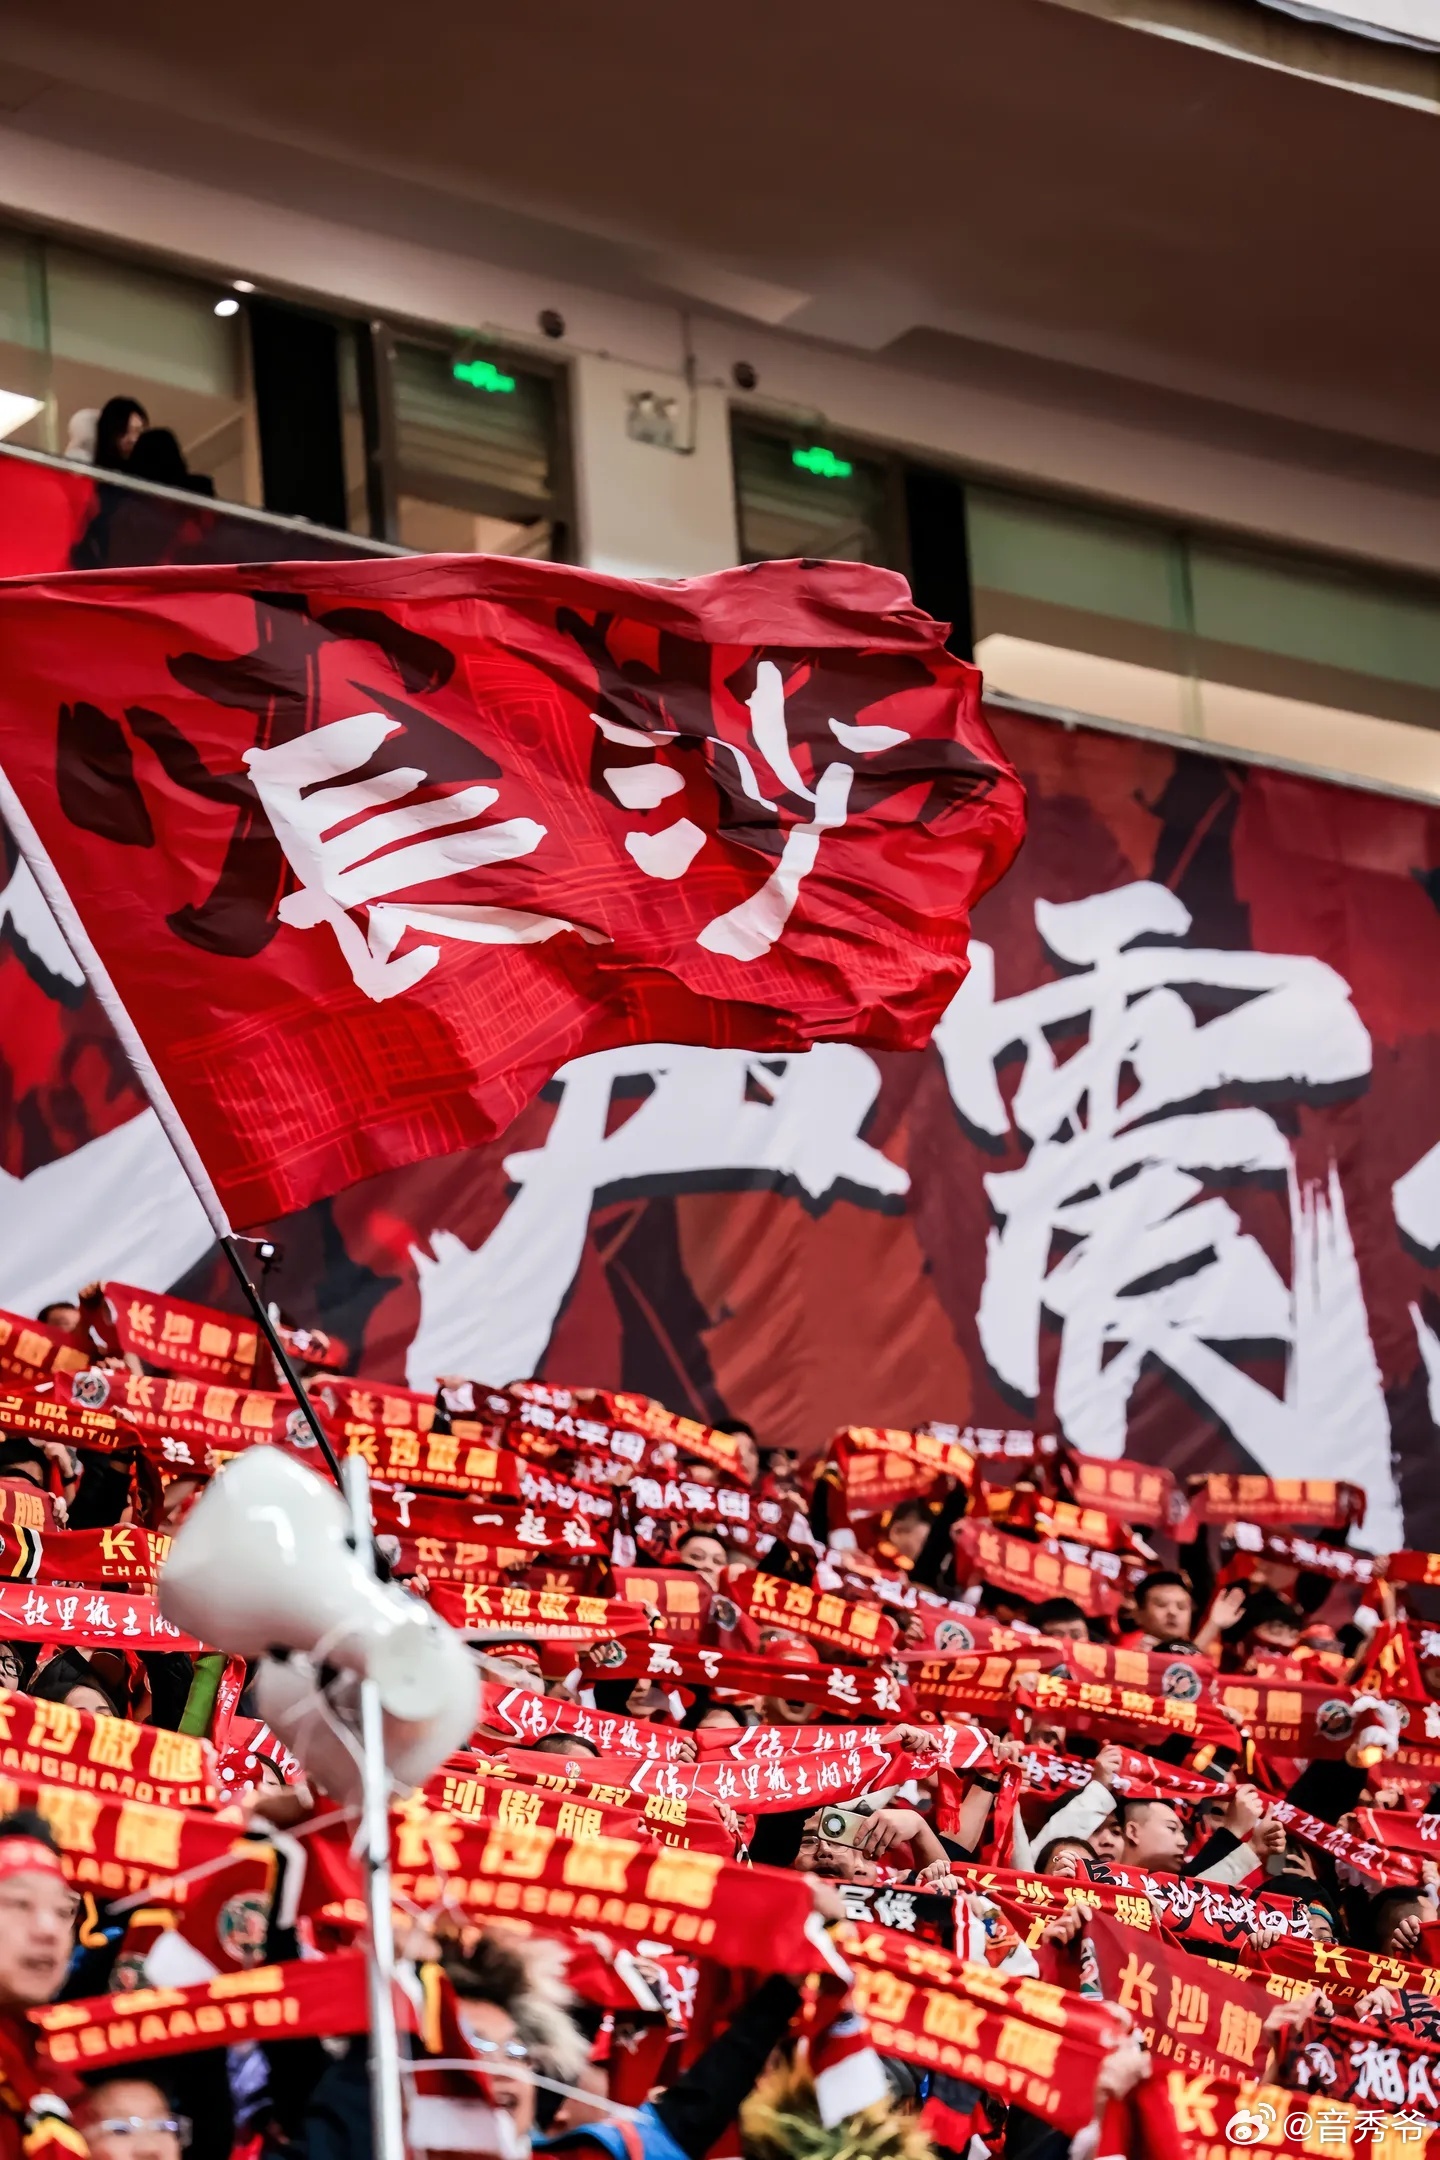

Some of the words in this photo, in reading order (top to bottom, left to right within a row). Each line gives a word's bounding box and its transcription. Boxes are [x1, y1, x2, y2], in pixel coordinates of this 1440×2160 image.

[241, 658, 911, 1002] 長沙
[1117, 1951, 1275, 2073] 长沙傲
[1349, 2040, 1440, 2110] 湘A
